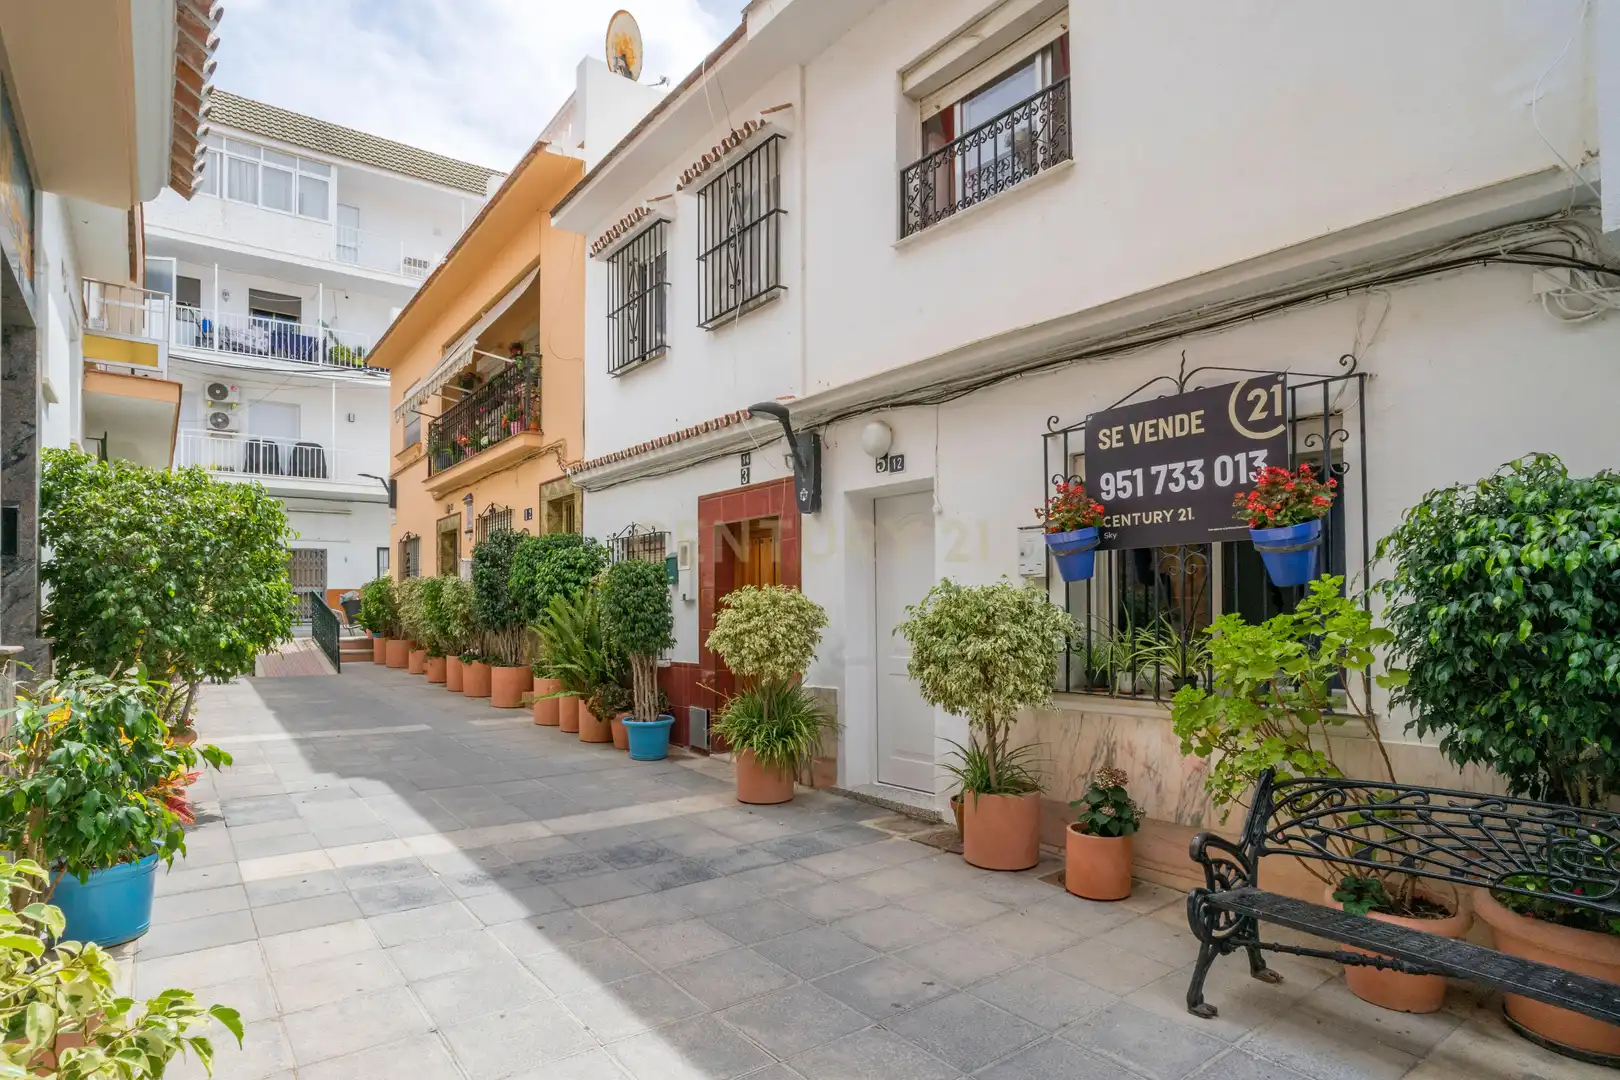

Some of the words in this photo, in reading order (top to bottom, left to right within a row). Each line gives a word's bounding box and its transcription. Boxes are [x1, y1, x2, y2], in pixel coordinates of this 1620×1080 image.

[1098, 425, 1124, 450] SE
[1129, 410, 1205, 445] VENDE
[892, 457, 903, 470] 12
[741, 468, 749, 484] 3
[1100, 468, 1144, 501] 951
[1150, 458, 1205, 495] 733
[1213, 449, 1268, 488] 013
[1103, 508, 1175, 529] CENTURY
[1103, 531, 1118, 541] Sky
